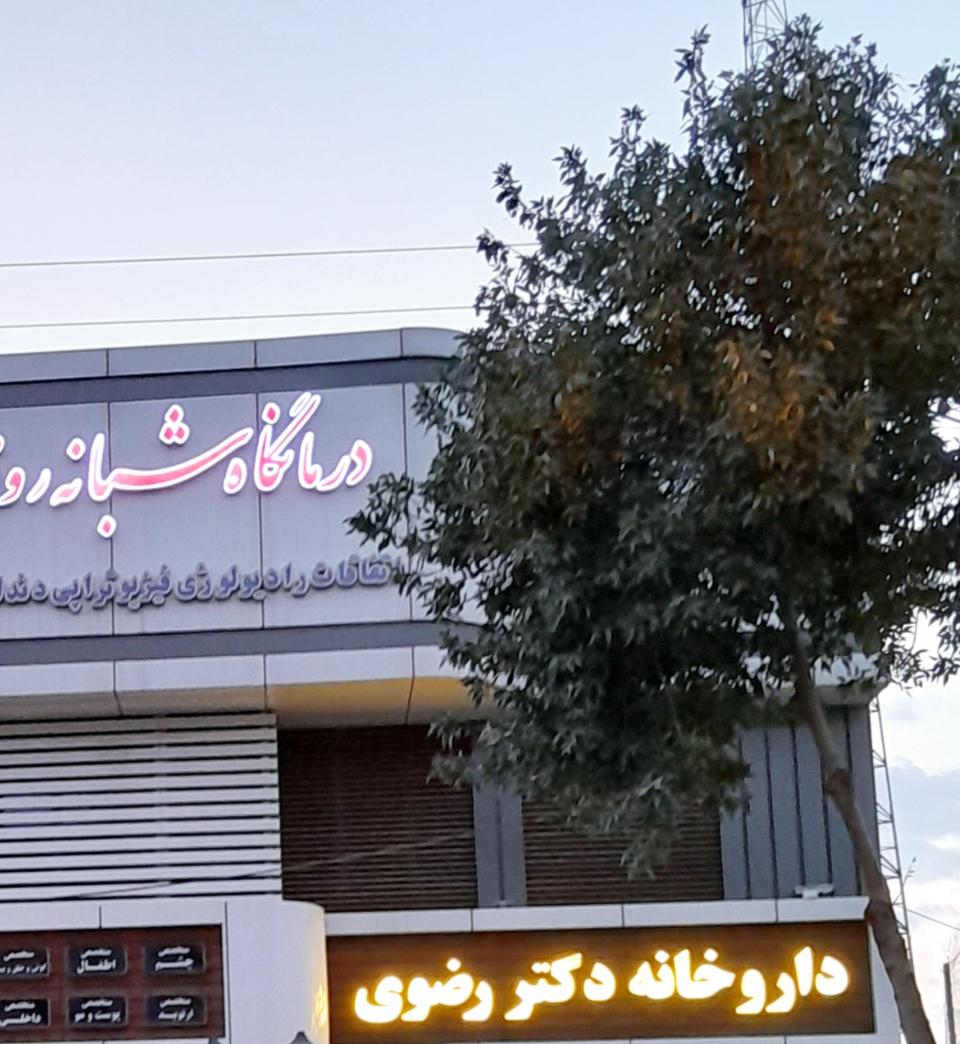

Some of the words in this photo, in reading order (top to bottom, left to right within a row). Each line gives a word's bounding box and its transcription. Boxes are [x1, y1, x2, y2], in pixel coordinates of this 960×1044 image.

[49, 403, 254, 538] شبانه
[223, 391, 372, 495] درمانگاه
[175, 561, 310, 601] رادیولوژی
[354, 956, 494, 1024] رضوی
[504, 952, 617, 1022] دکتر
[628, 945, 850, 1015] داروخانه
